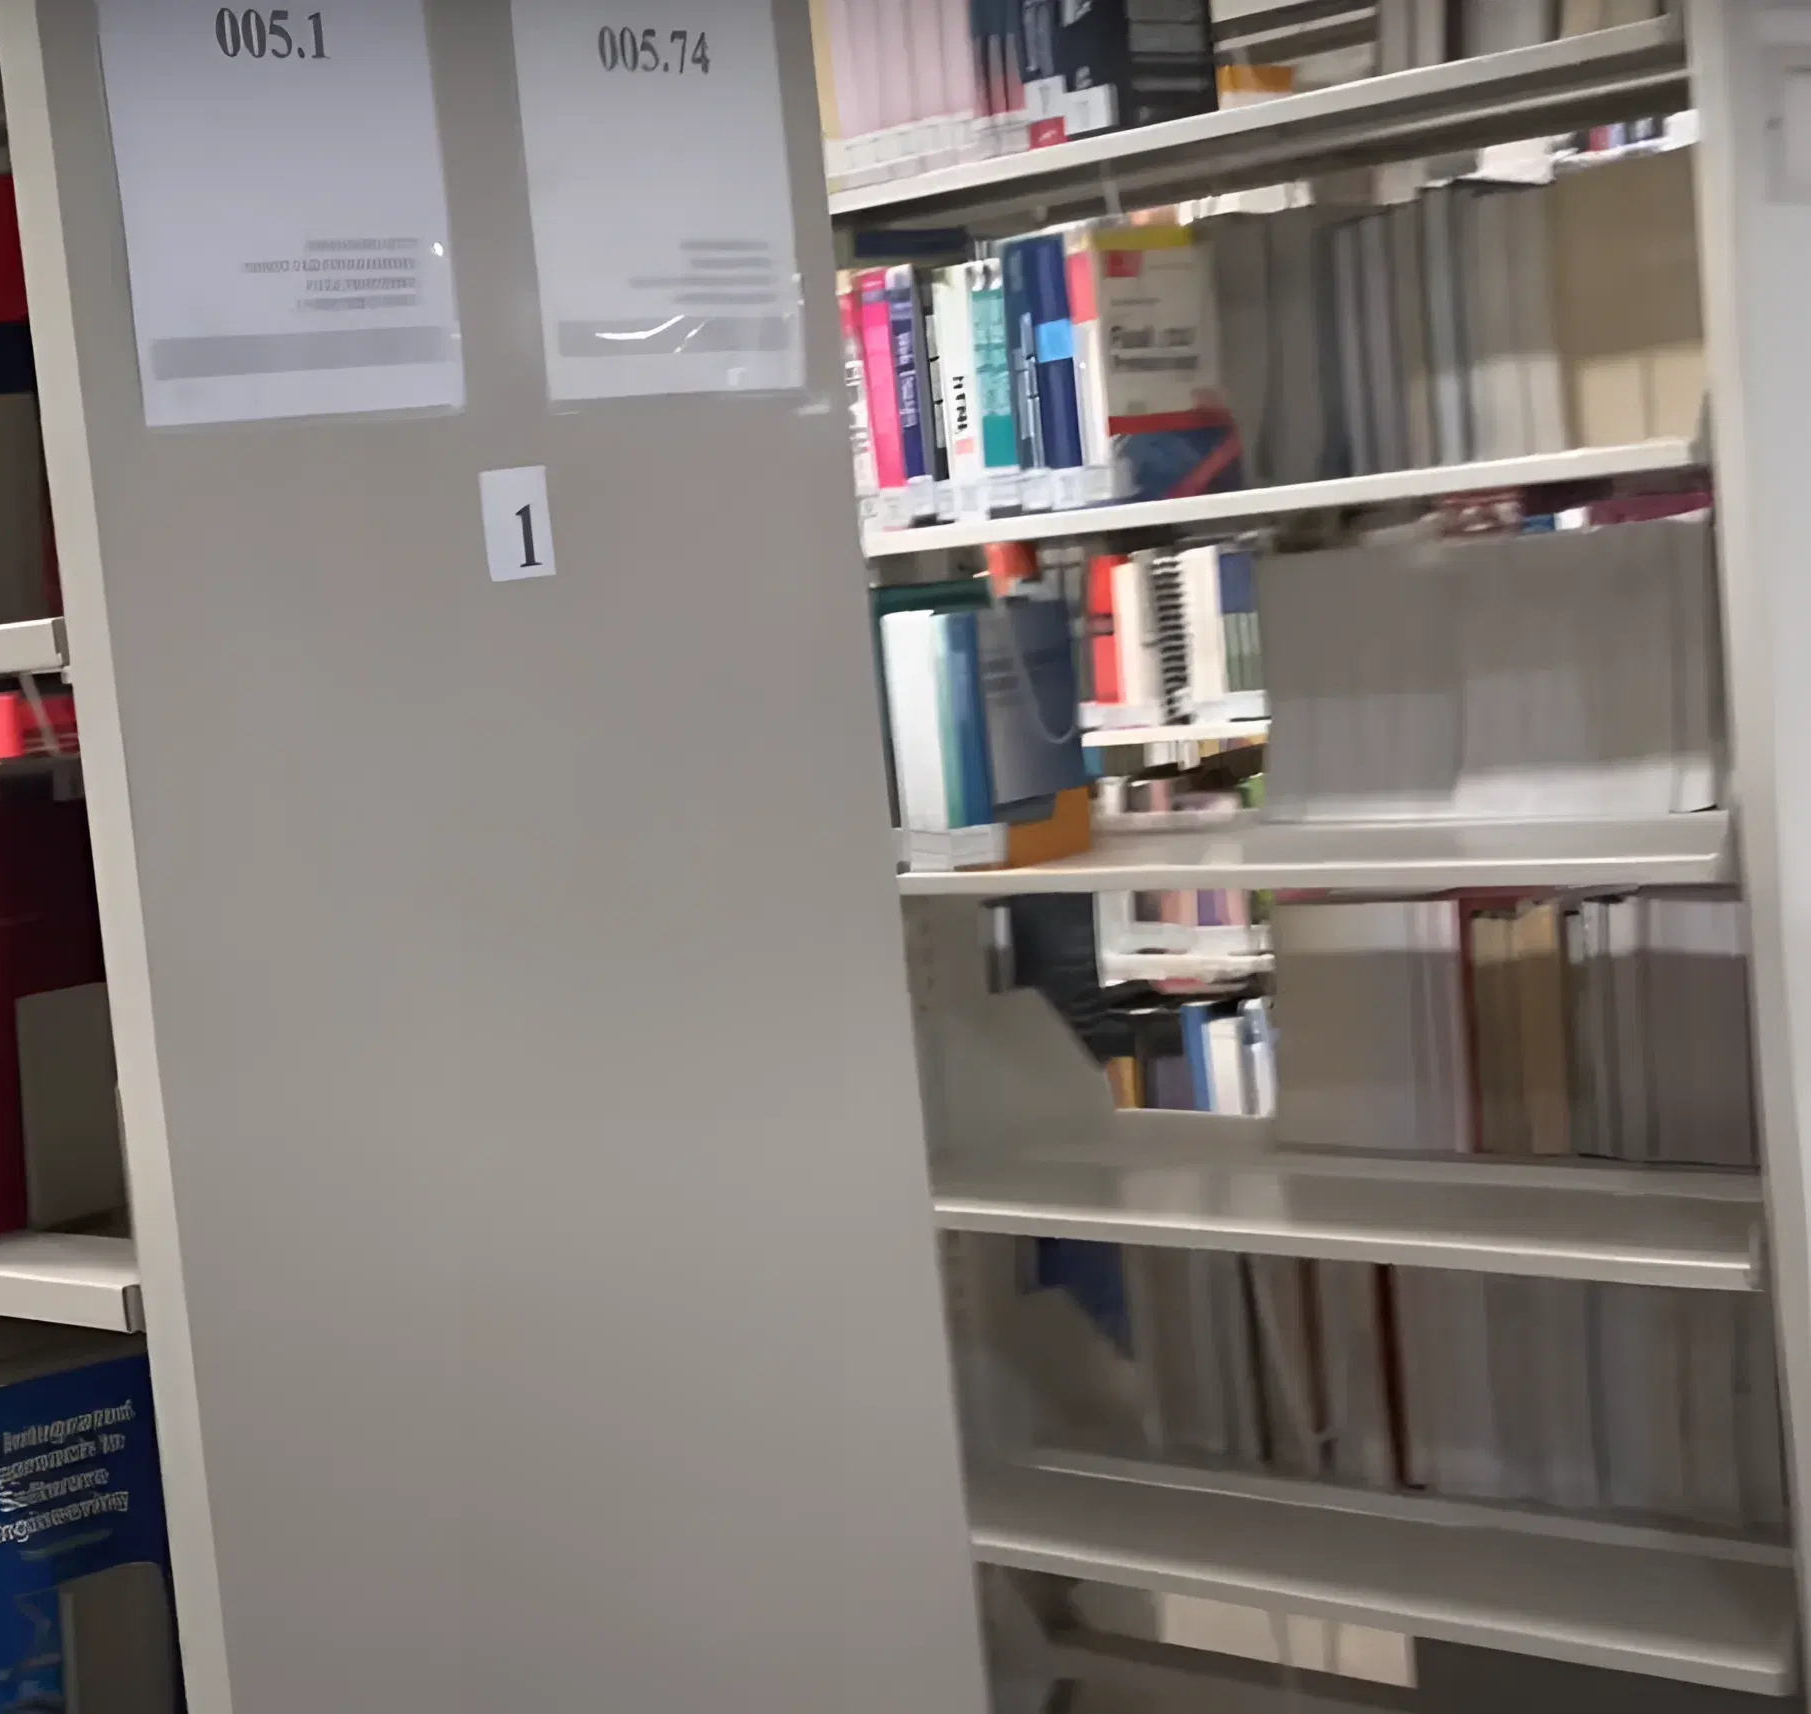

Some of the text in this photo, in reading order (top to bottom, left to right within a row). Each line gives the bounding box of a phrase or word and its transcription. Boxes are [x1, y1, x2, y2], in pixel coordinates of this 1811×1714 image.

[215, 7, 331, 59] 005.1
[597, 26, 711, 75] 005.74
[515, 503, 543, 567] 1
